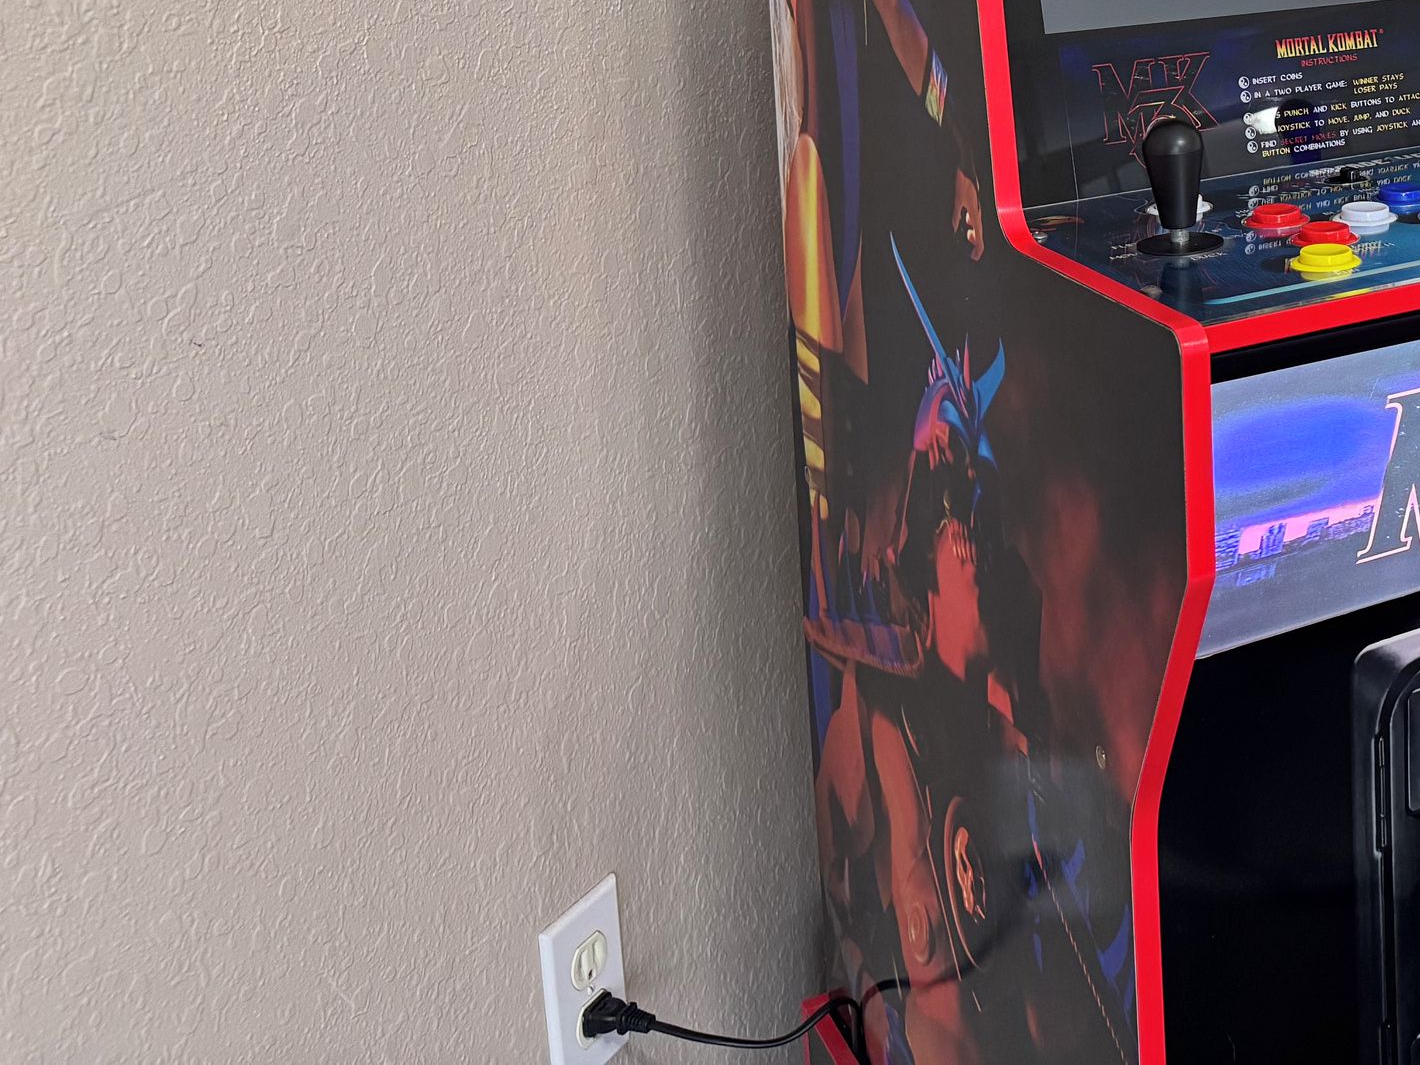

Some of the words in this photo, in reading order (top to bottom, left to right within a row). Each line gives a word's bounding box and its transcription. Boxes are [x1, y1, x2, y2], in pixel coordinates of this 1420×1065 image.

[1275, 34, 1327, 59] MORTAL
[1327, 29, 1378, 53] KOMBAT
[1301, 53, 1358, 67] INSTRUCTIONS
[1252, 75, 1276, 85] INSERT
[1280, 72, 1303, 82] COINS
[1254, 90, 1261, 99] IN
[1265, 89, 1271, 97] A
[1274, 87, 1292, 96] TWO
[1295, 83, 1323, 94] PLAYER
[1325, 80, 1348, 90] GAME:
[1352, 75, 1379, 86] WINNER
[1382, 72, 1405, 83] STAYS
[1353, 85, 1376, 95] LOSER
[1379, 82, 1398, 91] PAYS
[1284, 107, 1309, 118] PUNCH
[1313, 105, 1328, 114] AND
[1330, 102, 1348, 112] KICK
[1350, 98, 1382, 109] BUTTONS
[1384, 96, 1395, 104] TO
[1314, 119, 1325, 127] TO
[1375, 110, 1389, 119] AND
[1392, 107, 1411, 117] DUCK
[1260, 139, 1277, 149] FIND
[1281, 135, 1309, 146] SECRET
[1340, 129, 1349, 138] BY
[1352, 126, 1373, 136] USING
[1376, 121, 1408, 132] JOYSTICK
[1262, 147, 1291, 158] BUTTON
[1294, 139, 1346, 153] COMBINATIONS
